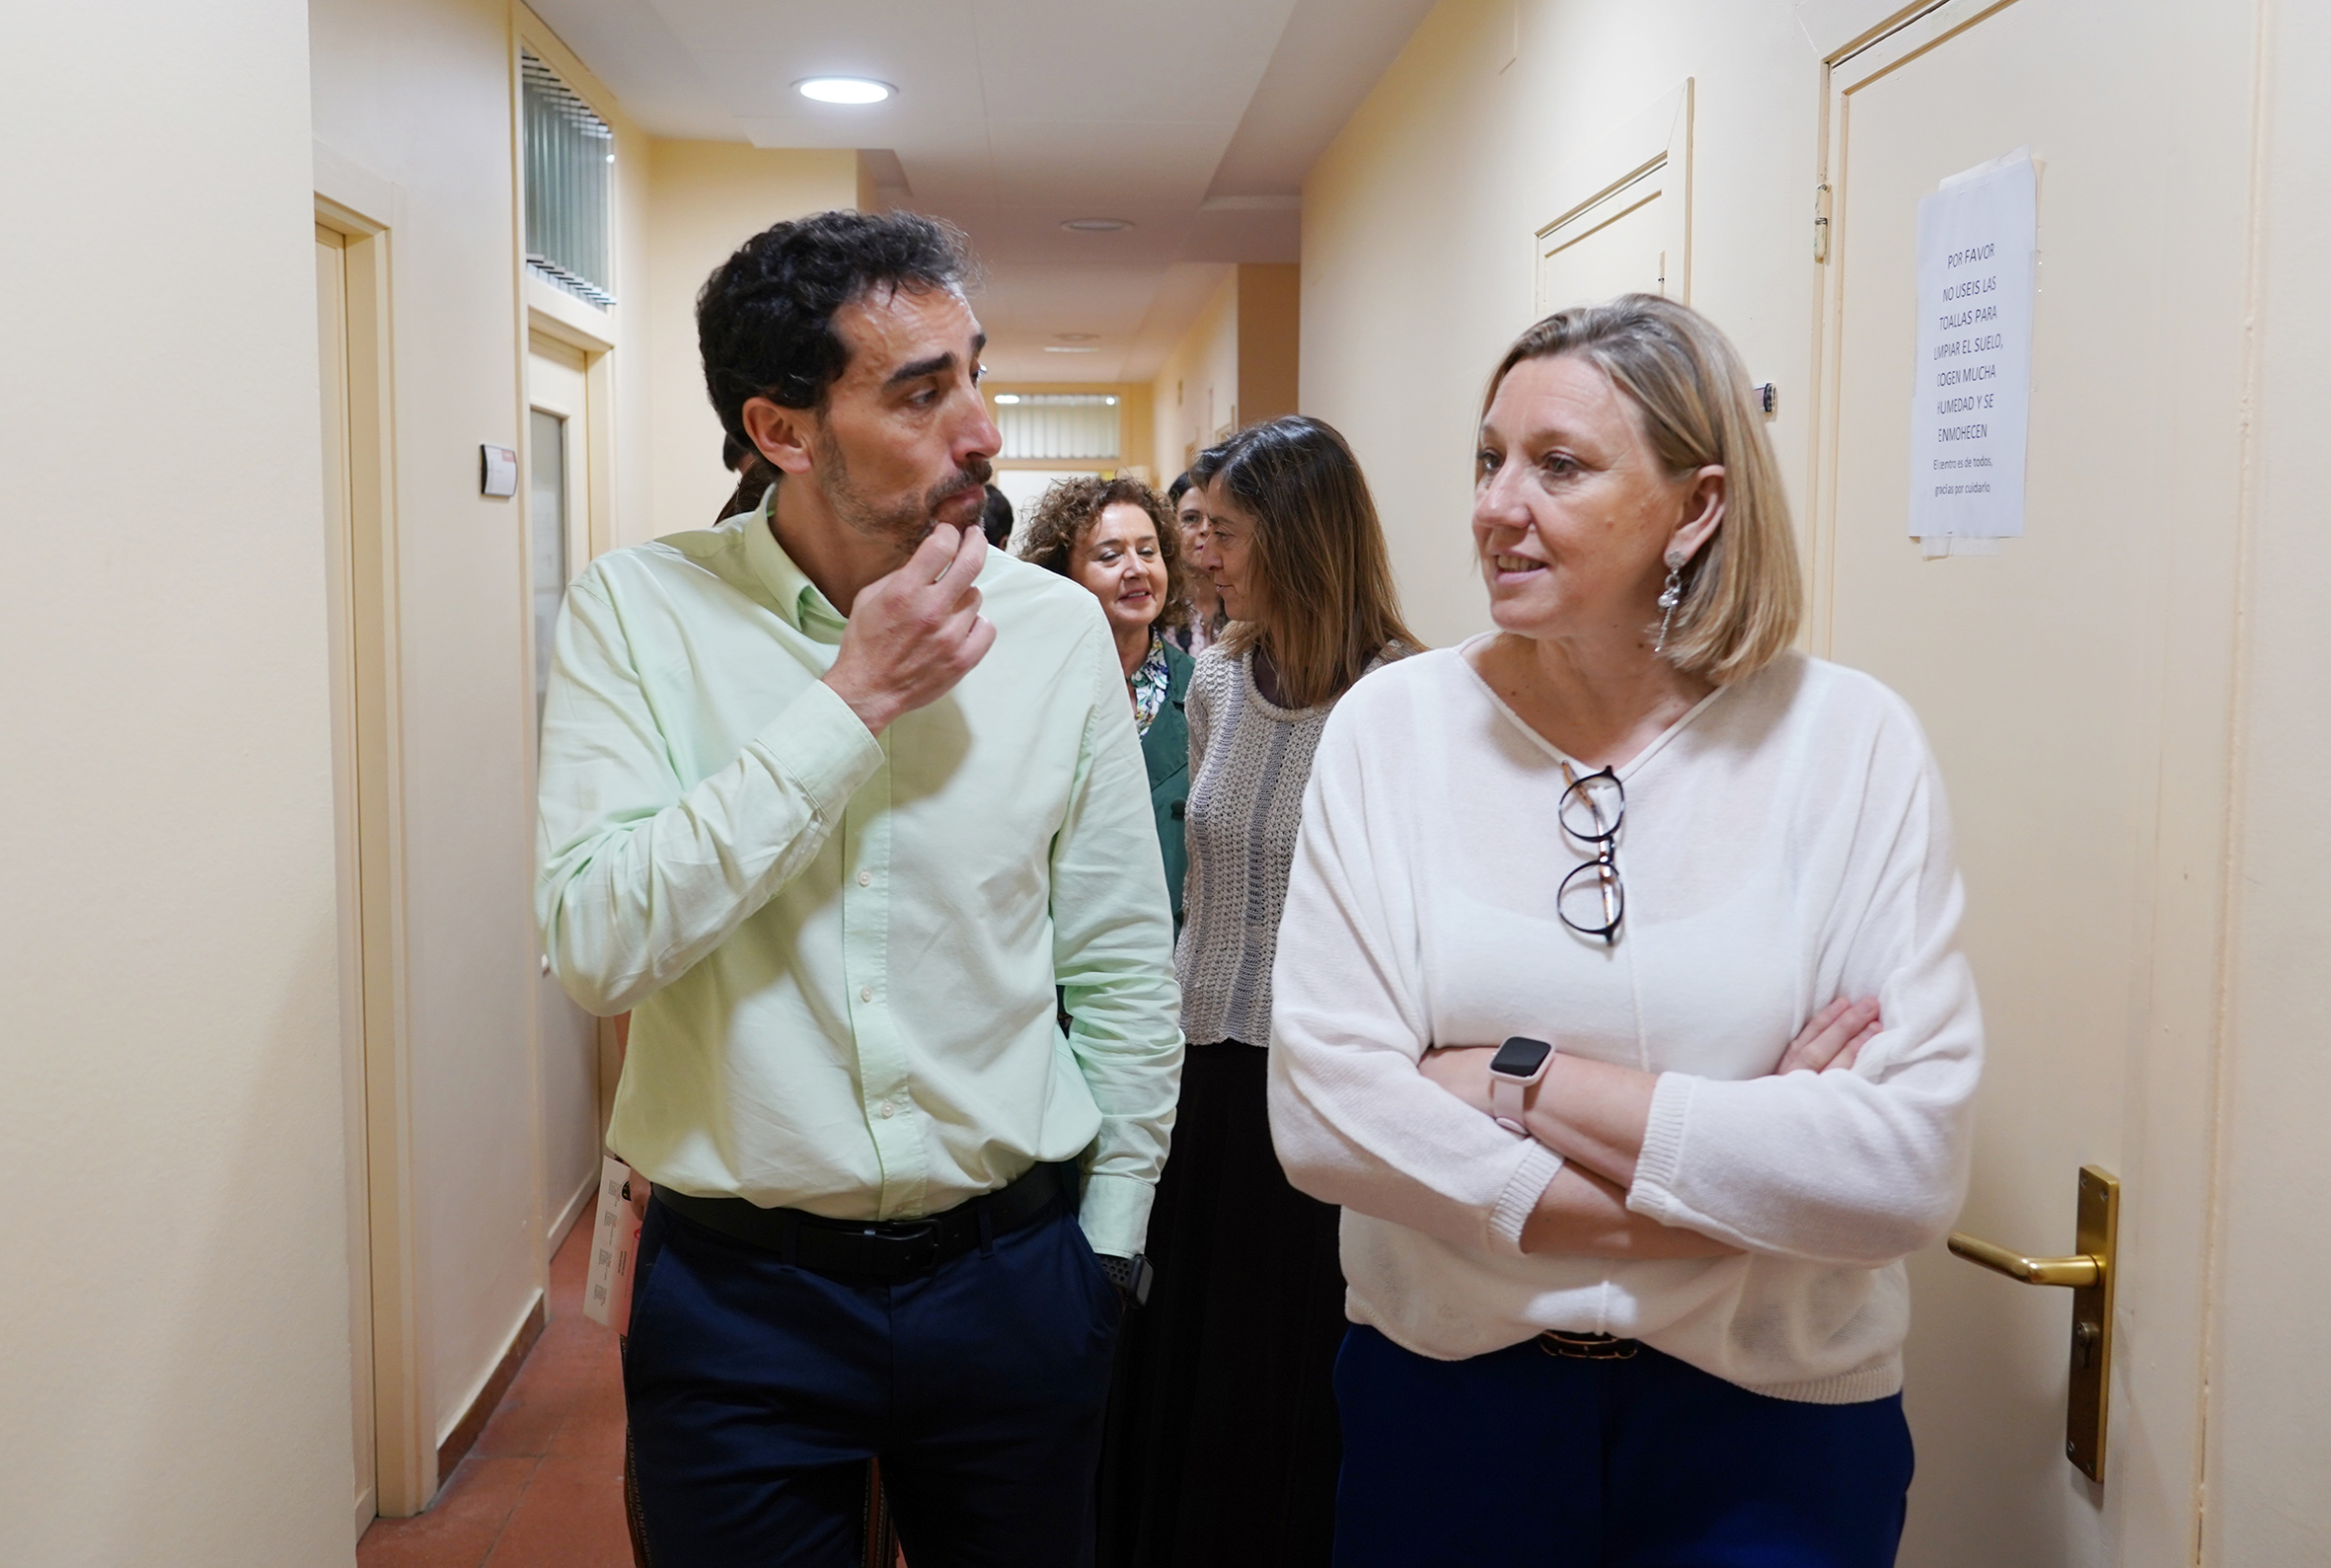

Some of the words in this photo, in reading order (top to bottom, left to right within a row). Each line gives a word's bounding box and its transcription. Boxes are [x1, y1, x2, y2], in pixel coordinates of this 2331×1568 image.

[1948, 253, 1963, 268] POR
[1965, 243, 1994, 263] FAVOR
[1943, 287, 1954, 302] NO
[1955, 280, 1981, 298] USEIS
[1983, 275, 1996, 292] LAS
[1939, 310, 1973, 331] TOALLAS
[1975, 306, 1996, 323] PARA
[1962, 339, 1972, 354] EL
[1975, 334, 2003, 352] SUELO,
[1963, 365, 1996, 382] MUCHA
[1977, 396, 1983, 409] Y
[1984, 394, 1993, 409] SE
[1938, 424, 1988, 442] ENMOHECEN
[1958, 459, 1963, 468] es
[1965, 456, 1972, 468] de
[1934, 484, 1954, 497] gracias
[1955, 485, 1964, 496] por
[1965, 482, 1991, 493] cuidarlo
